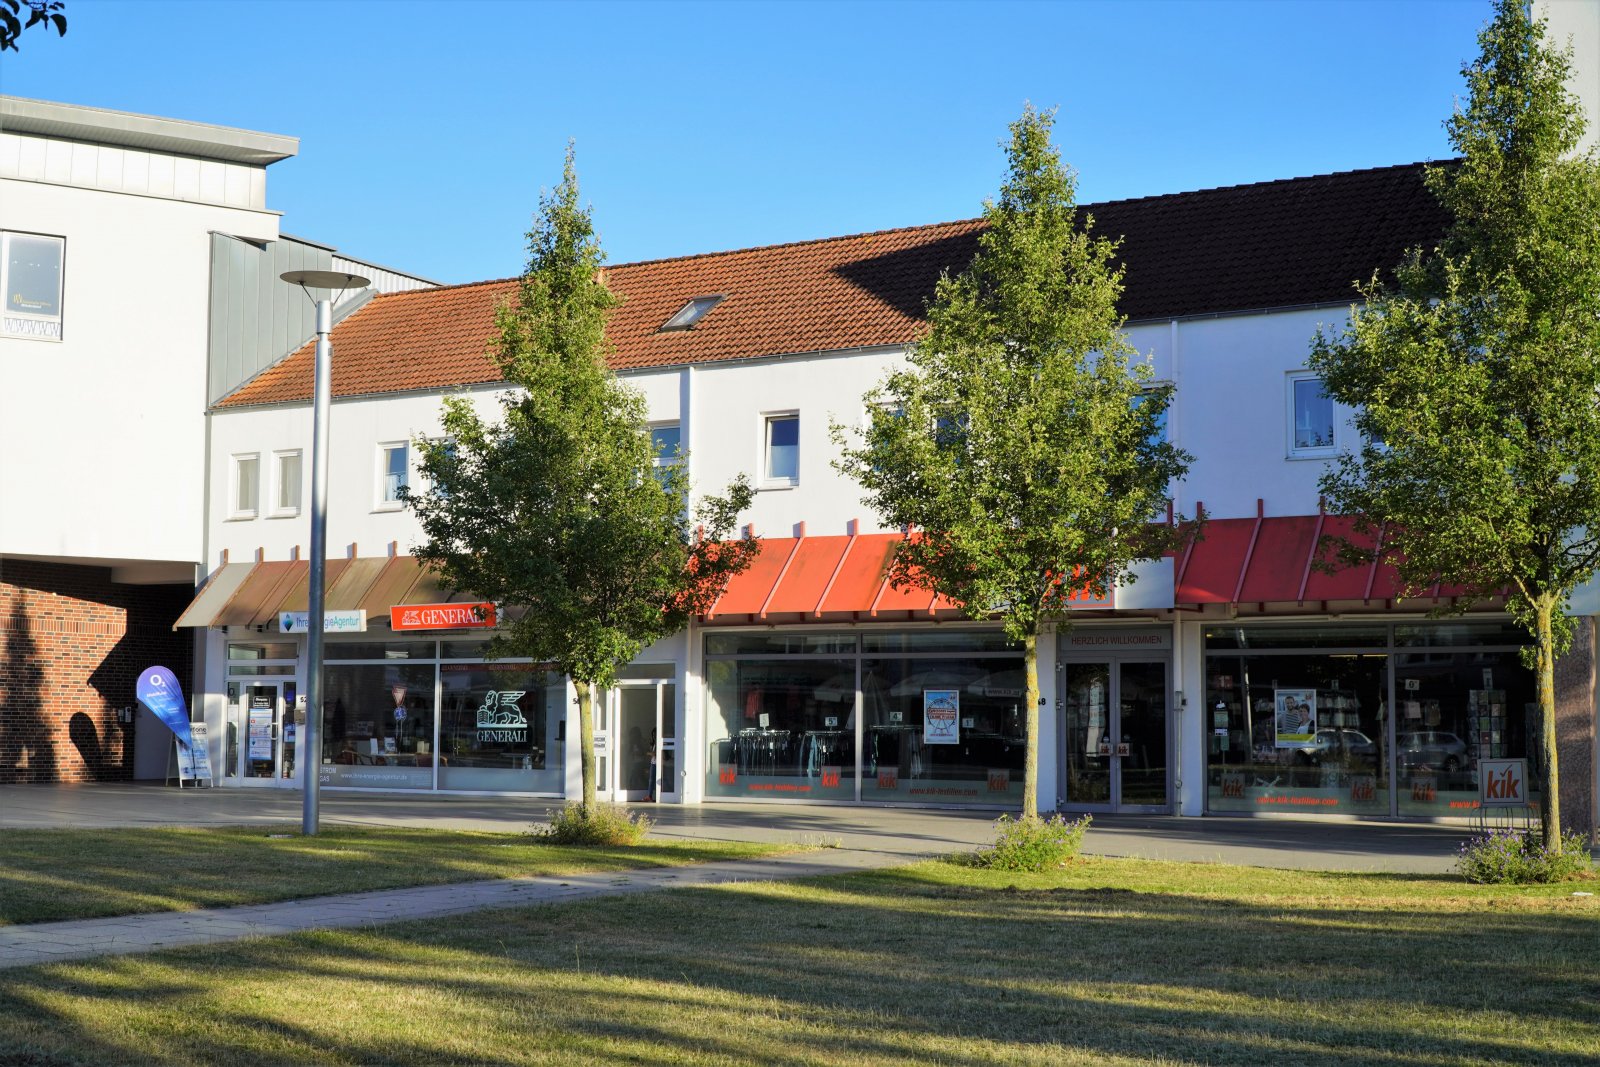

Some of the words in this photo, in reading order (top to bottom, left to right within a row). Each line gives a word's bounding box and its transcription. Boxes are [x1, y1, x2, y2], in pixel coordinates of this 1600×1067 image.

[296, 615, 359, 629] IhregieAgentur
[1071, 636, 1109, 645] HERZLICH
[1110, 635, 1161, 645] WILLKOMMEN
[477, 730, 527, 743] GENERALI
[719, 767, 736, 785] kik
[821, 770, 840, 788] kik
[879, 772, 896, 788] kik
[989, 775, 1007, 790] kik
[1487, 769, 1519, 799] kik
[1222, 778, 1242, 798] kik
[1352, 781, 1373, 800] kik
[1412, 782, 1436, 801] kik
